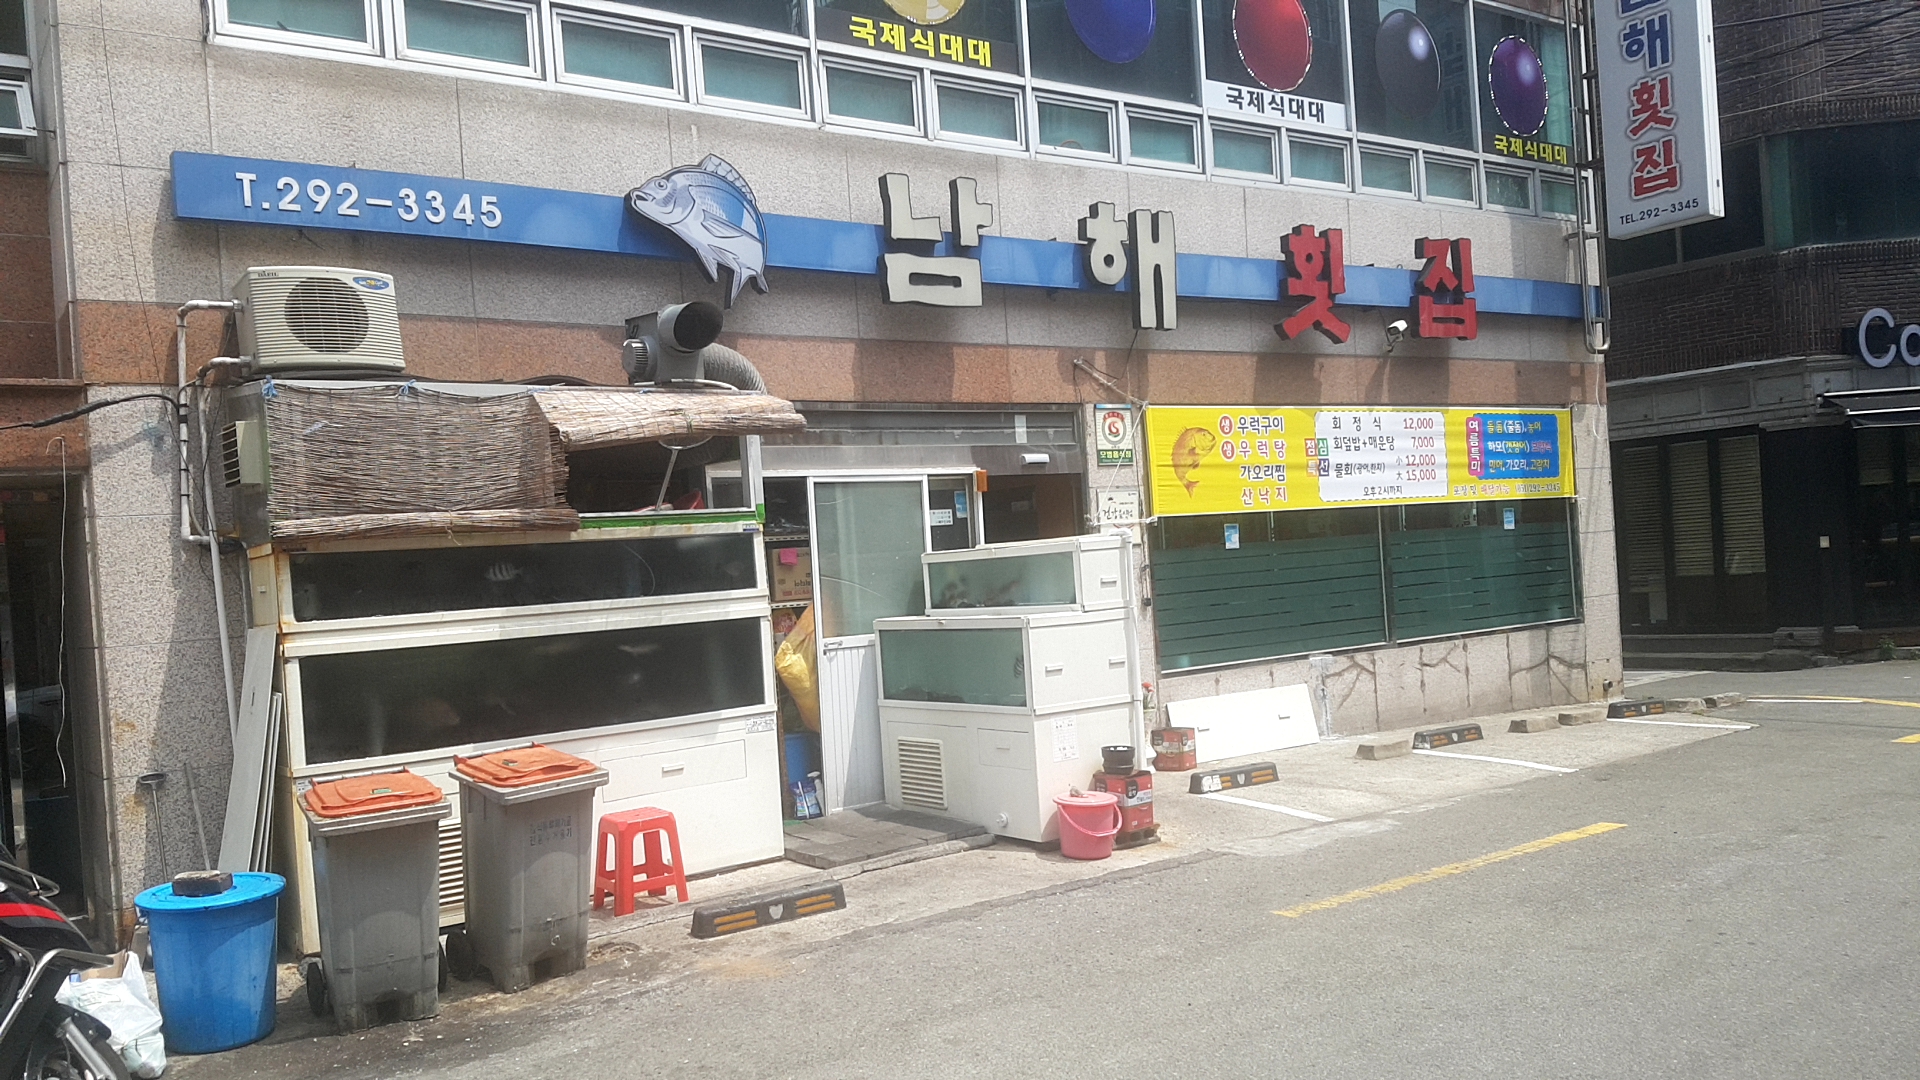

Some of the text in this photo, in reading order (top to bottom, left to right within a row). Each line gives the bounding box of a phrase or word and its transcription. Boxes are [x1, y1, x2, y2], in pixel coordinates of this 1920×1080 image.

[849, 15, 992, 68] 국제식대대
[1225, 86, 1325, 124] 국제식대대
[1620, 0, 1679, 198] 해 횟집
[1494, 134, 1567, 165] 국제식대대
[235, 171, 503, 229] T.292-3345
[1620, 198, 1699, 225] TEL.292-3345
[1274, 223, 1478, 345] 횟집
[1220, 416, 1284, 434] 생 우럭구이
[1403, 418, 1434, 430] 12,000
[1222, 440, 1286, 459] 생 우럭탕
[1305, 438, 1328, 456] 점심
[1411, 437, 1435, 449] 7,000
[1405, 455, 1436, 467] 12,000
[1240, 464, 1286, 482] 가오리찜
[1406, 469, 1436, 482] 15,000
[1241, 487, 1287, 506] 산낙지
